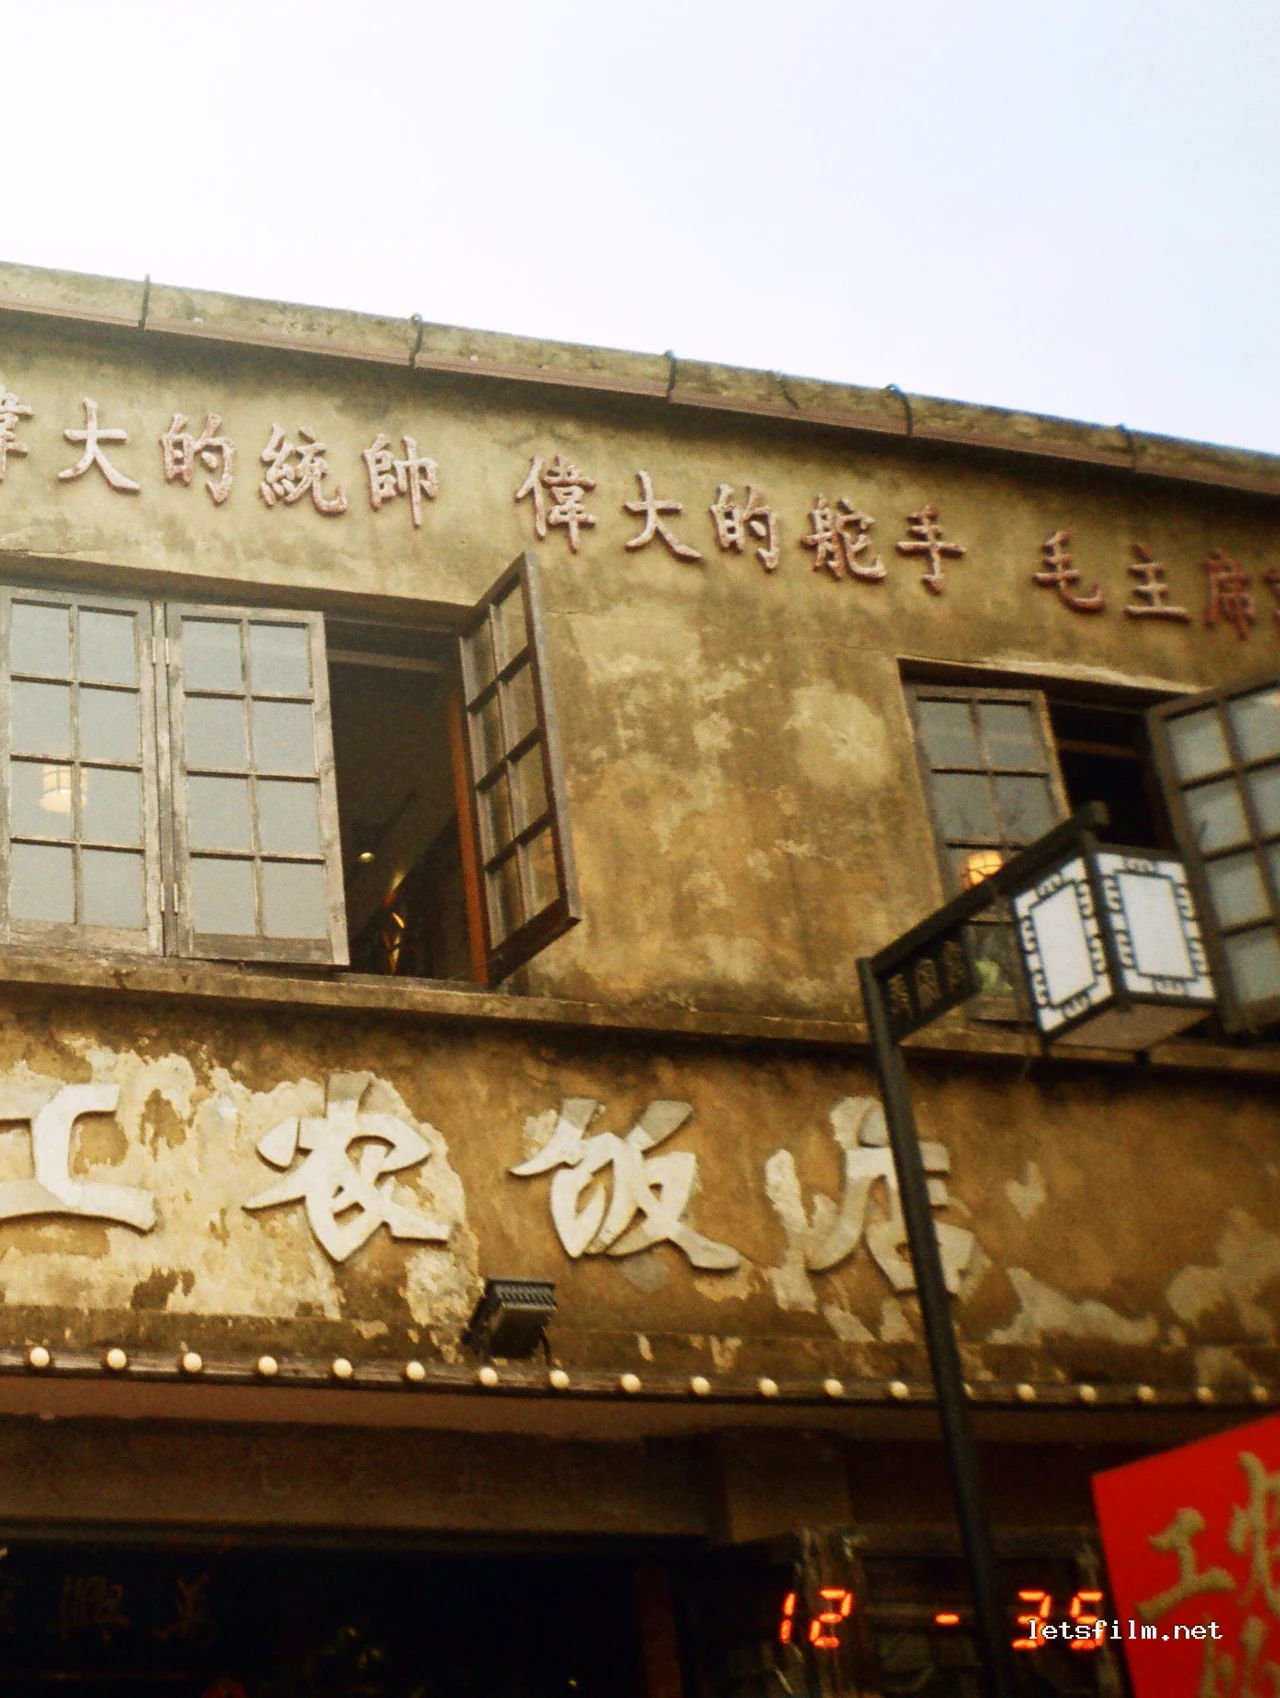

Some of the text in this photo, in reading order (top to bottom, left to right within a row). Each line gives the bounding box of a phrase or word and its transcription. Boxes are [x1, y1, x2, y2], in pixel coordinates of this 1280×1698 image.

[514, 455, 967, 595] 偉大的舵手
[1031, 530, 1280, 641] 毛主席
